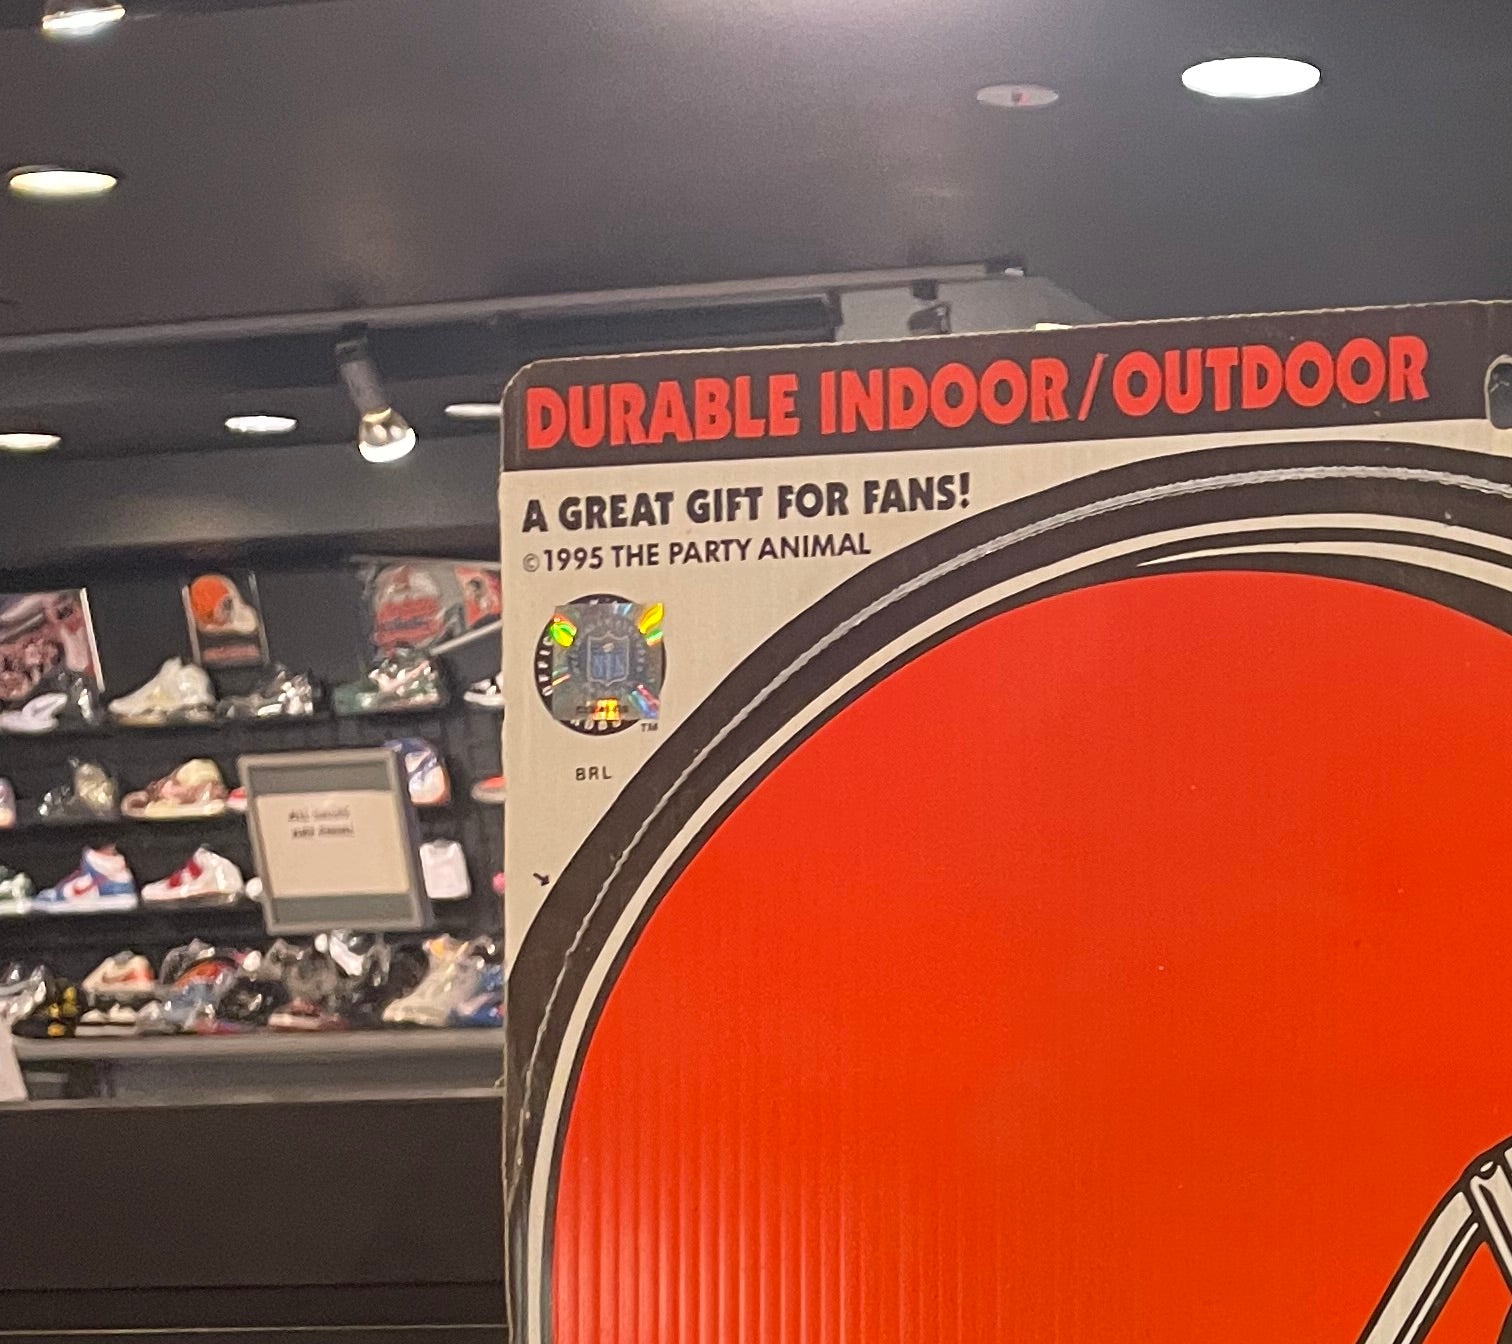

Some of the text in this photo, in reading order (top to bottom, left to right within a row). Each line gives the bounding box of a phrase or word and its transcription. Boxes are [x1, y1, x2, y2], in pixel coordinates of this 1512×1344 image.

[526, 373, 800, 450] DURABLE
[521, 471, 971, 534] A GREAT GIFT FOR FANS!
[610, 542, 660, 569] THE
[668, 536, 752, 566] PARTY
[757, 532, 872, 561] ANIMAL
[575, 765, 613, 781] BRL
